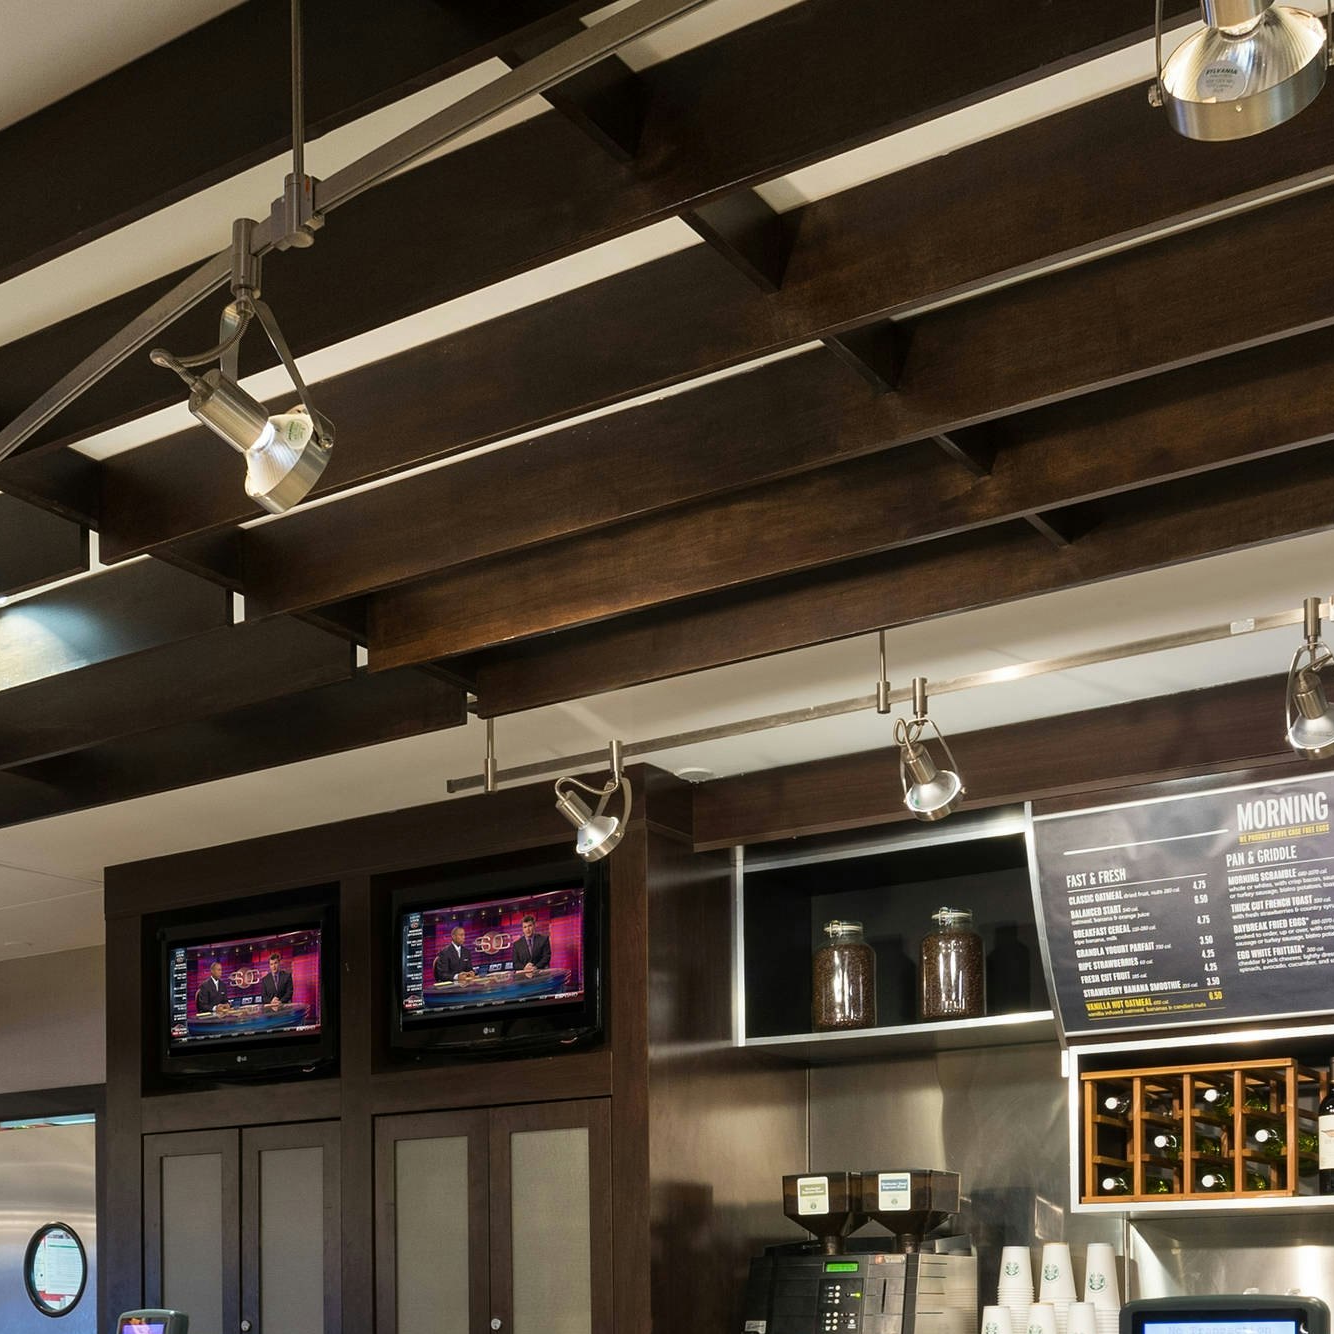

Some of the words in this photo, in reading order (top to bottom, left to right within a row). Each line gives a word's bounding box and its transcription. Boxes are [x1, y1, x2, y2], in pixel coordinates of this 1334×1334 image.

[1237, 792, 1328, 831] MORNING
[1226, 853, 1244, 867] PAN
[1248, 851, 1254, 864] &
[1257, 845, 1297, 863] GRIDDLE
[1067, 873, 1087, 888] FAST
[1090, 872, 1096, 884] &
[1099, 868, 1126, 884] FRESH
[1228, 873, 1259, 885] MORNING
[1260, 869, 1297, 881] SCRAMBLE
[1069, 895, 1094, 905] CLASSIC
[1095, 891, 1123, 902] OATMEAL
[1265, 897, 1290, 909] FRENCH
[1292, 895, 1313, 907] TOAST
[1071, 908, 1102, 919] BALANCED
[1103, 905, 1121, 915] START
[1081, 974, 1100, 984] FRESH
[1114, 972, 1131, 981] FRUIT
[1083, 986, 1122, 998] STRAWBERRY
[1124, 983, 1149, 993] BANANA
[1150, 981, 1181, 991] SMOOTHIE
[1086, 1001, 1111, 1011] VANILLA
[1125, 998, 1152, 1008] OATMEAL
[1191, 1327, 1272, 1334] Transacon
